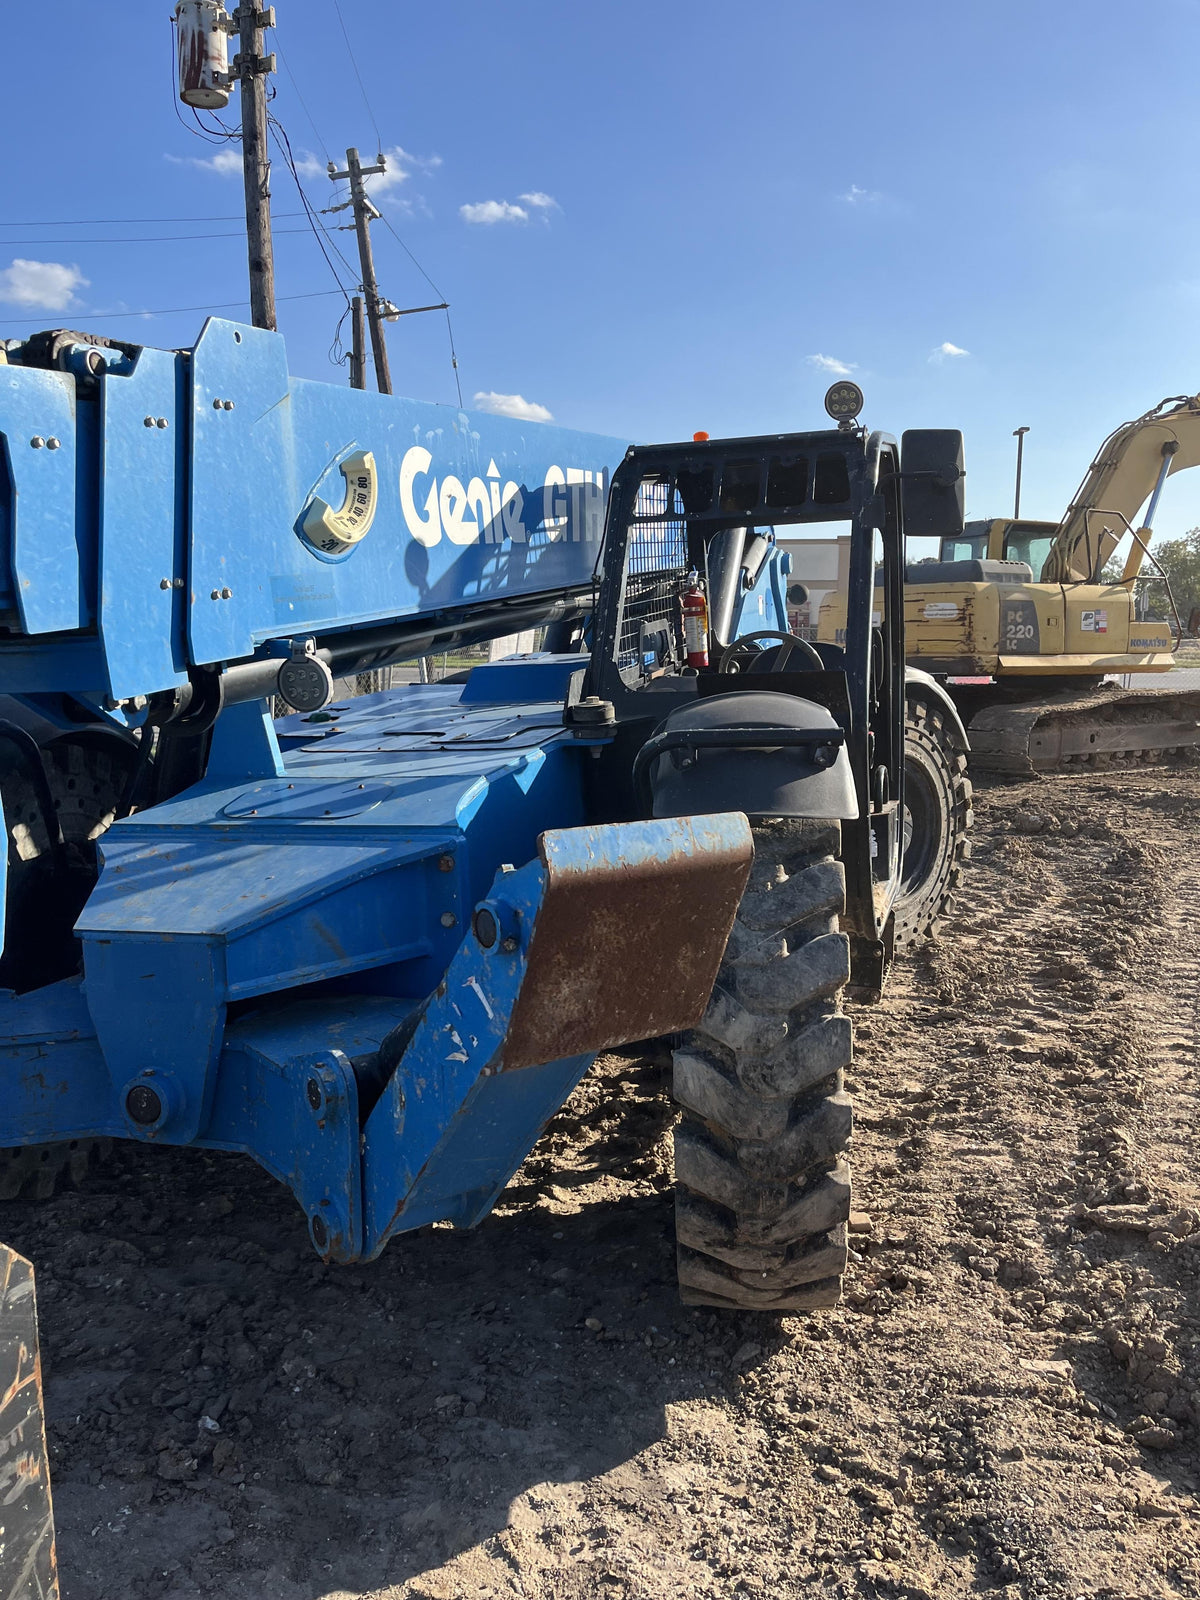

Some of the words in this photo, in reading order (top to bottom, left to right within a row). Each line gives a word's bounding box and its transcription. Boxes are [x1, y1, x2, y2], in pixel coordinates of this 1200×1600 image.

[357, 476, 368, 489] 80
[356, 493, 367, 505] 60
[399, 446, 526, 547] Genie
[353, 506, 364, 517] 40
[1007, 610, 1024, 623] PC
[1006, 625, 1034, 639] 220
[1006, 639, 1018, 650] LC
[1130, 637, 1167, 648] KOMATSU
